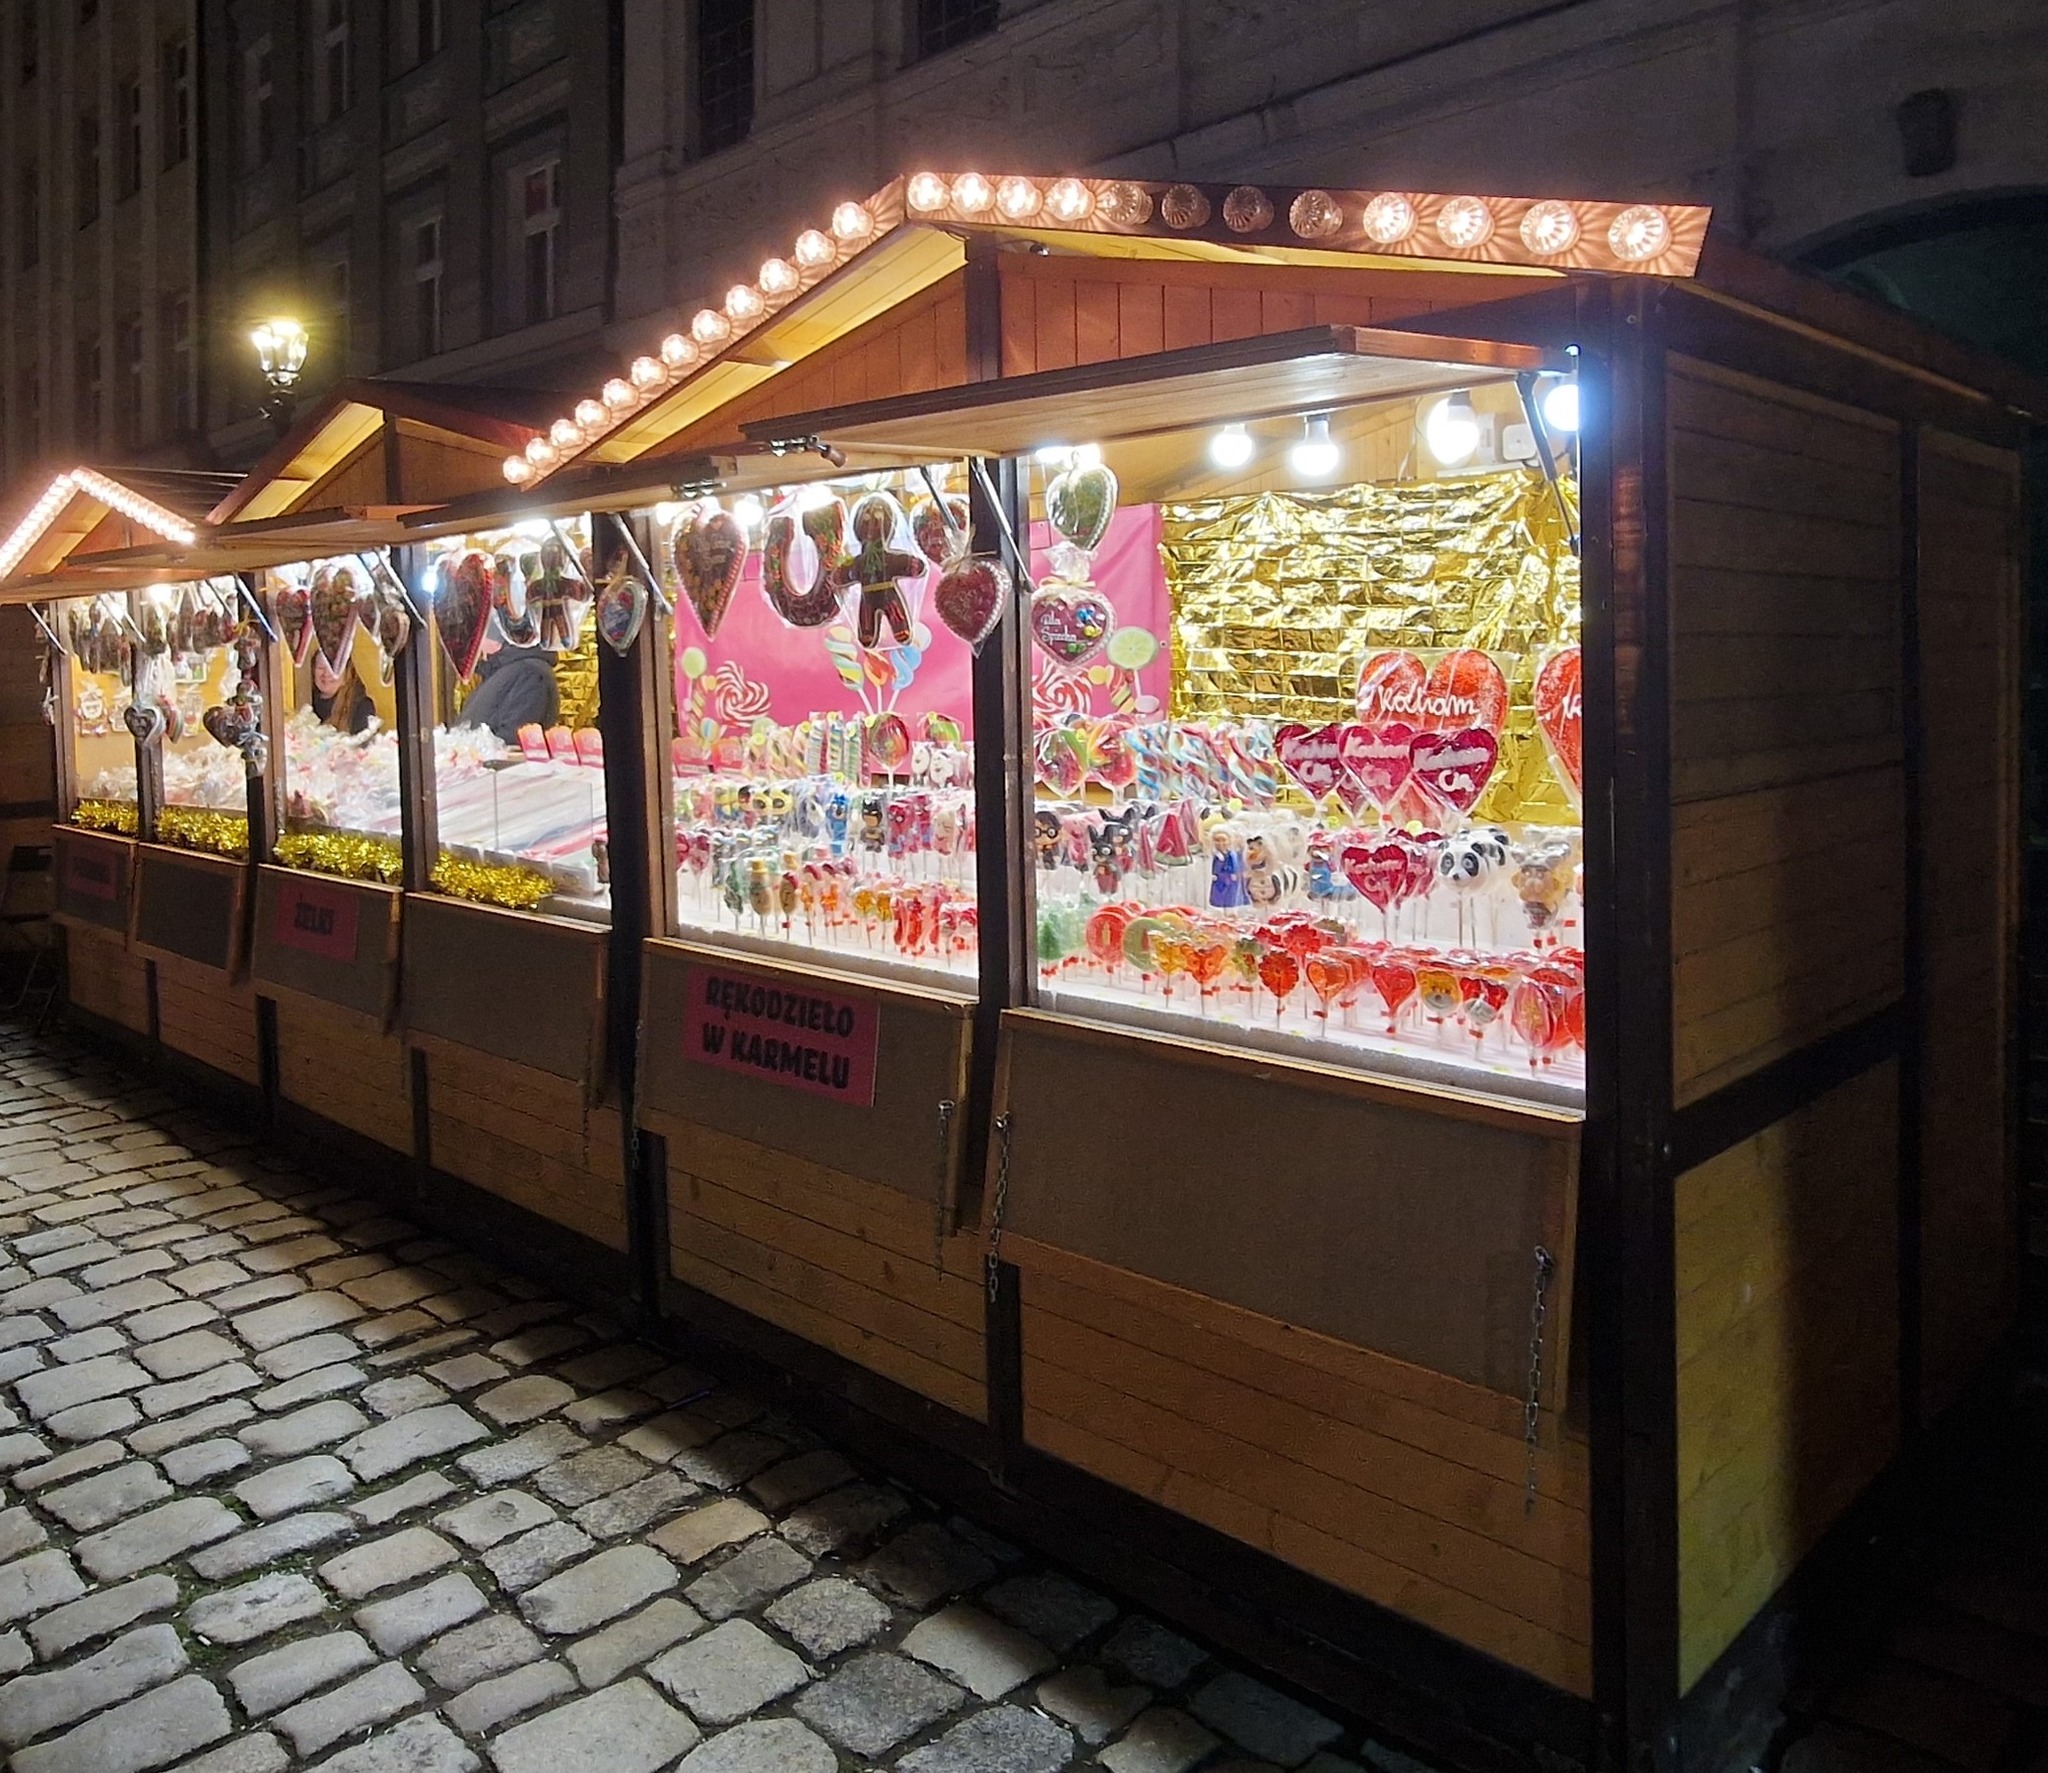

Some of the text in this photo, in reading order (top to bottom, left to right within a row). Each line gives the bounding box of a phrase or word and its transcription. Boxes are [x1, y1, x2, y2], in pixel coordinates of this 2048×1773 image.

[706, 977, 854, 1038] RĘKODZIEŁO
[703, 1022, 849, 1089] W KARMELU
